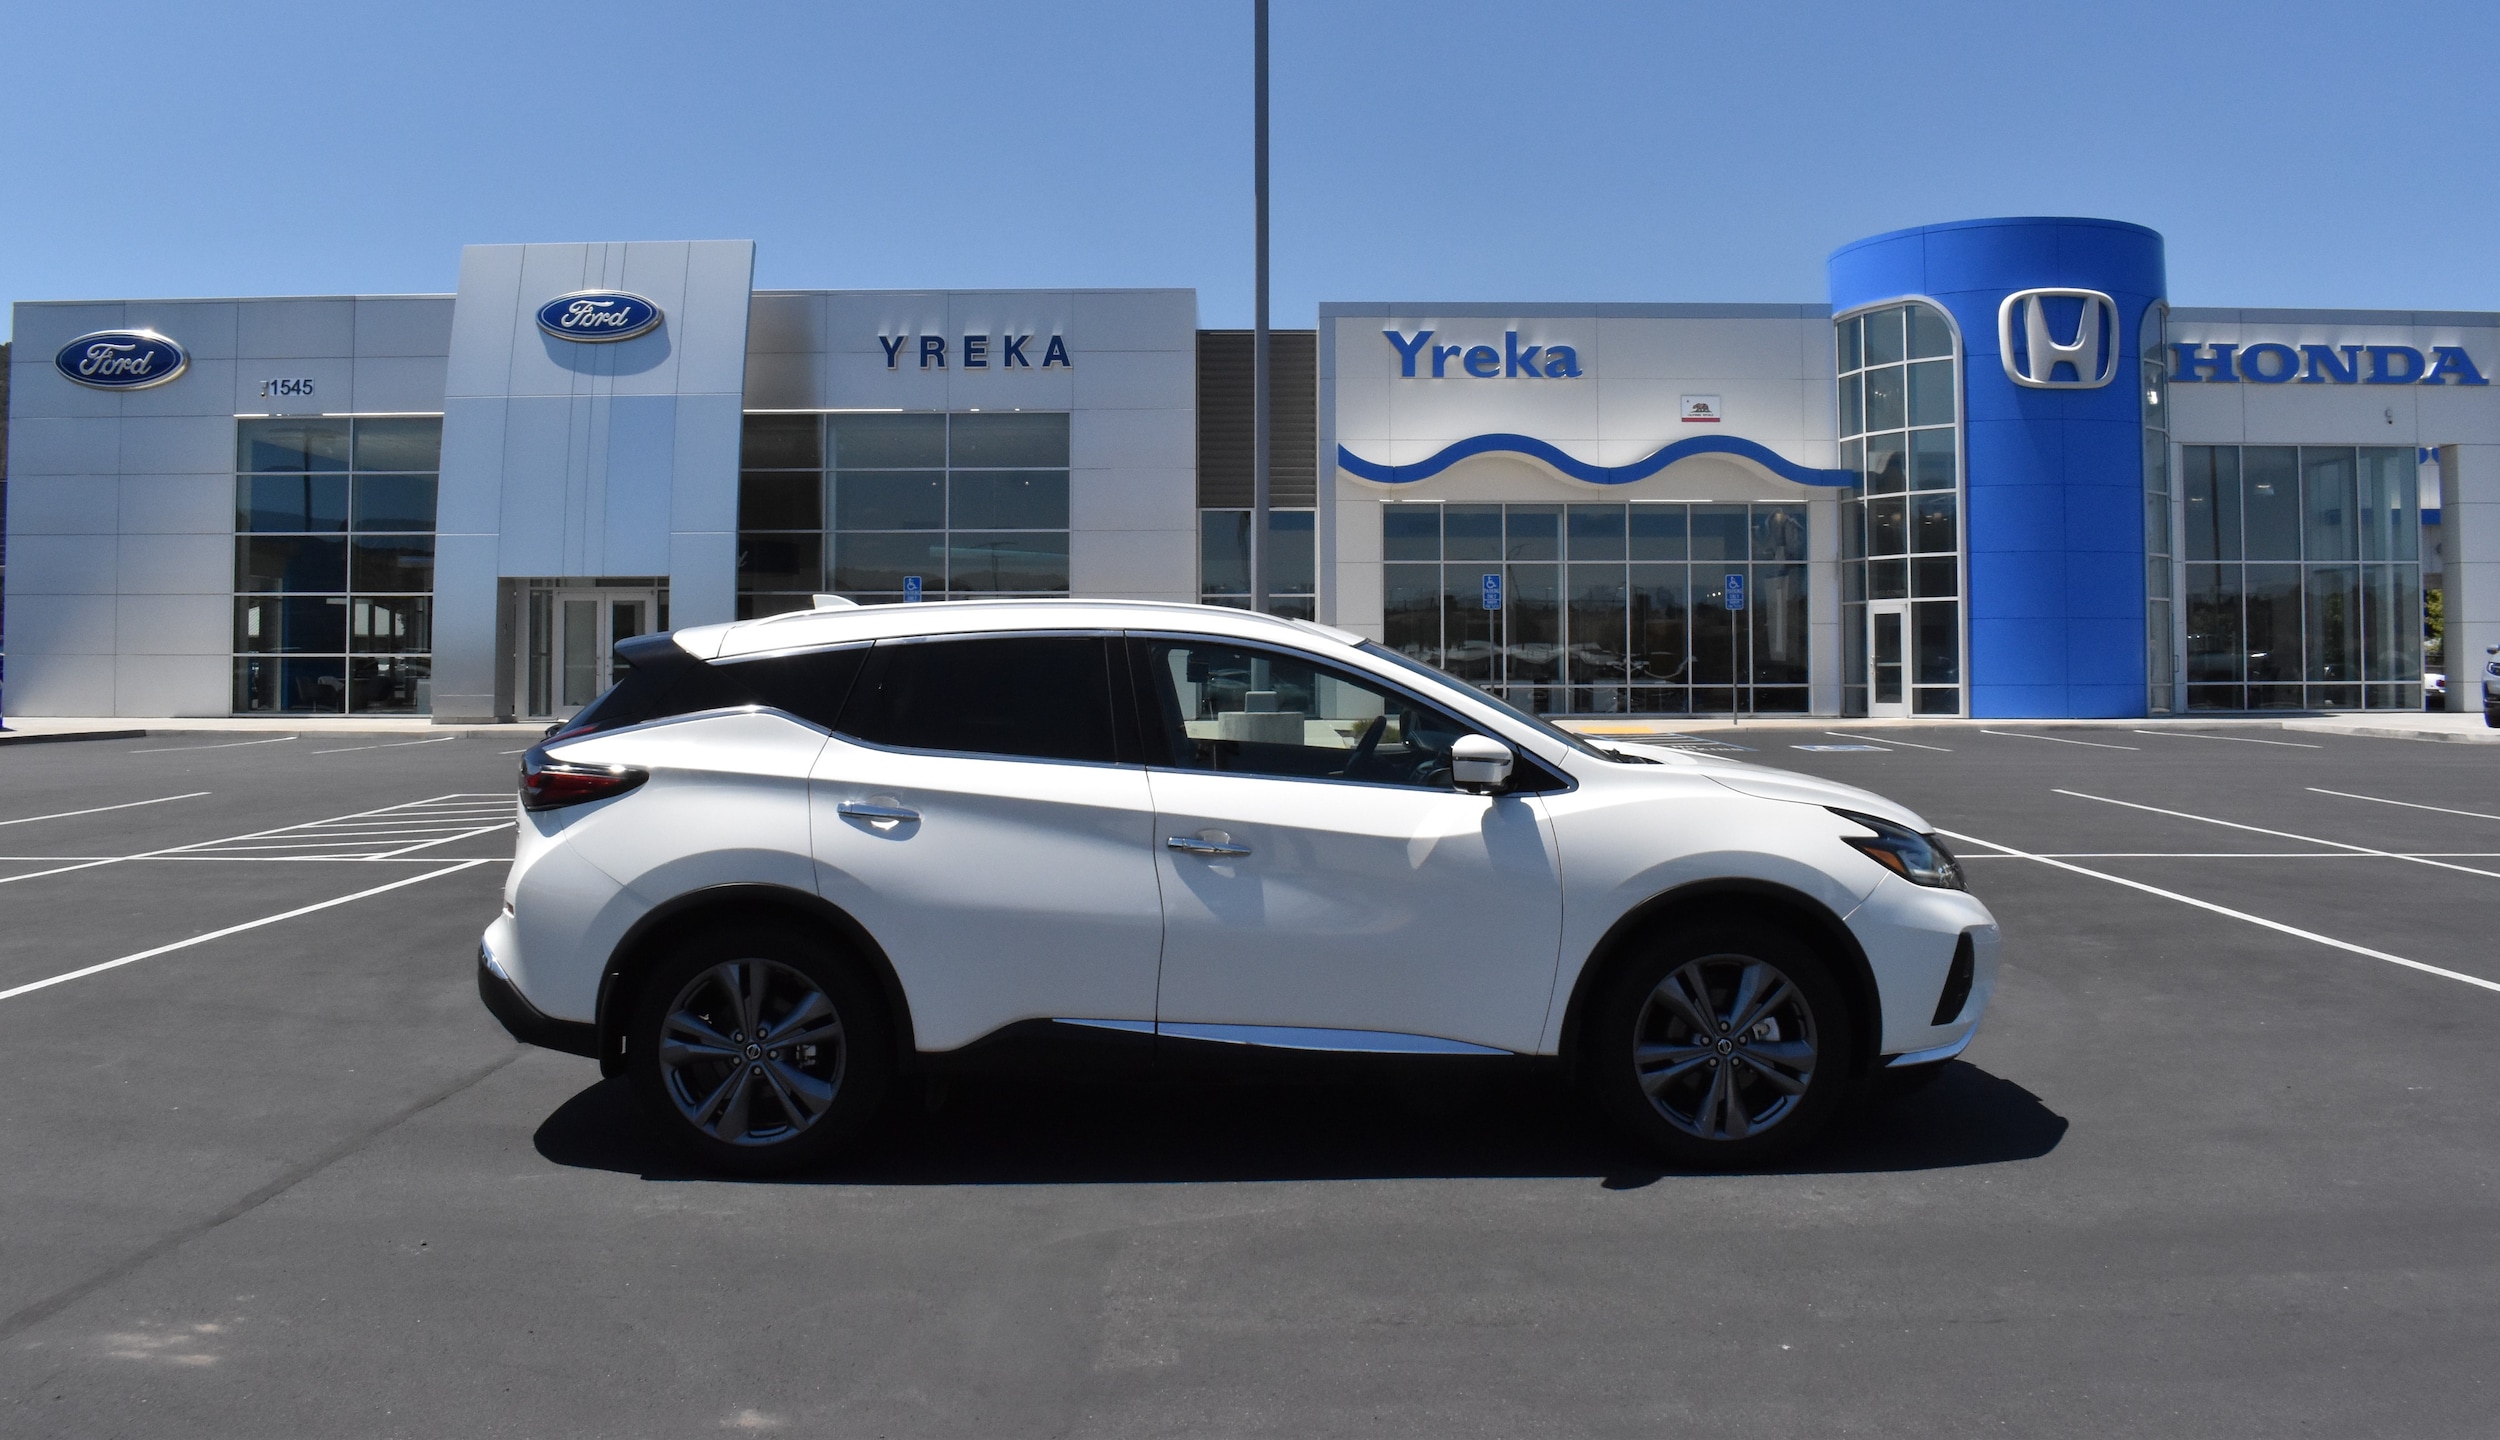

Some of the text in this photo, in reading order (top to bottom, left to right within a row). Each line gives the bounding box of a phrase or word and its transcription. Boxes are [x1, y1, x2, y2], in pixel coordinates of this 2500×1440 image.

[561, 300, 631, 328] Ford
[79, 343, 154, 375] Ford
[878, 333, 1073, 370] YREKA
[1382, 330, 1583, 379] Yreka
[2168, 342, 2490, 386] HONDA
[270, 379, 313, 395] 1545
